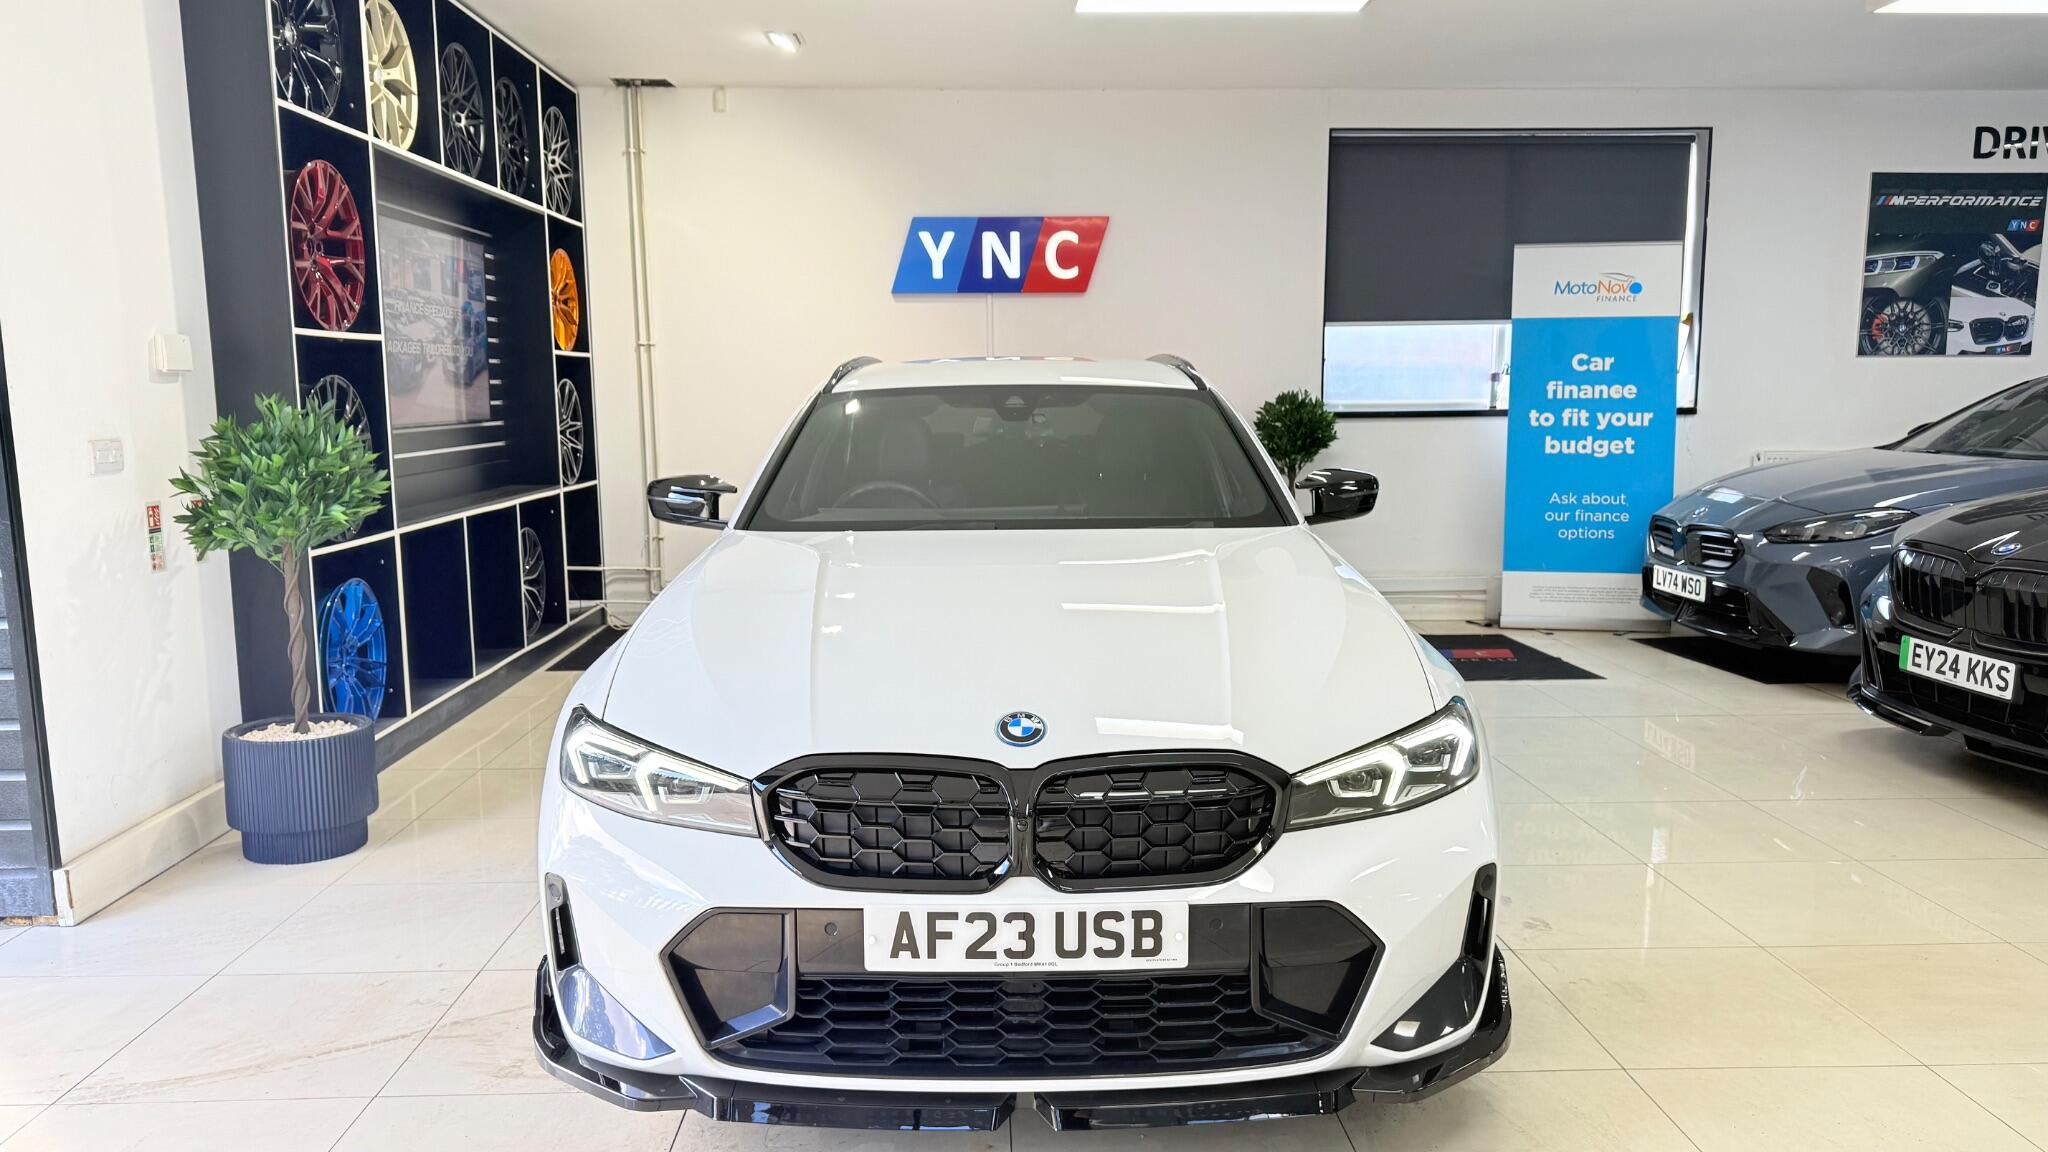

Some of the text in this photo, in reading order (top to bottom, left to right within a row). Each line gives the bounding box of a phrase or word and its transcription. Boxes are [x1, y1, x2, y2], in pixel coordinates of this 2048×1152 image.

[1973, 126, 2048, 159] DRI
[2010, 219, 2037, 230] YNC
[917, 230, 1080, 280] YNC
[1596, 295, 1637, 303] FINANCE
[386, 341, 421, 353] ACKAGES
[1572, 353, 1615, 372] Car
[1546, 381, 1638, 400] finance
[1529, 408, 1654, 430] to fit your
[1545, 436, 1635, 457] budget
[1549, 492, 1627, 505] Ask about
[1544, 509, 1630, 522] our finance
[1558, 527, 1615, 541] options
[1656, 569, 1702, 597] LV74 WSO
[1911, 643, 2011, 692] EY24 KKS
[890, 910, 1163, 959] AF23 USB
